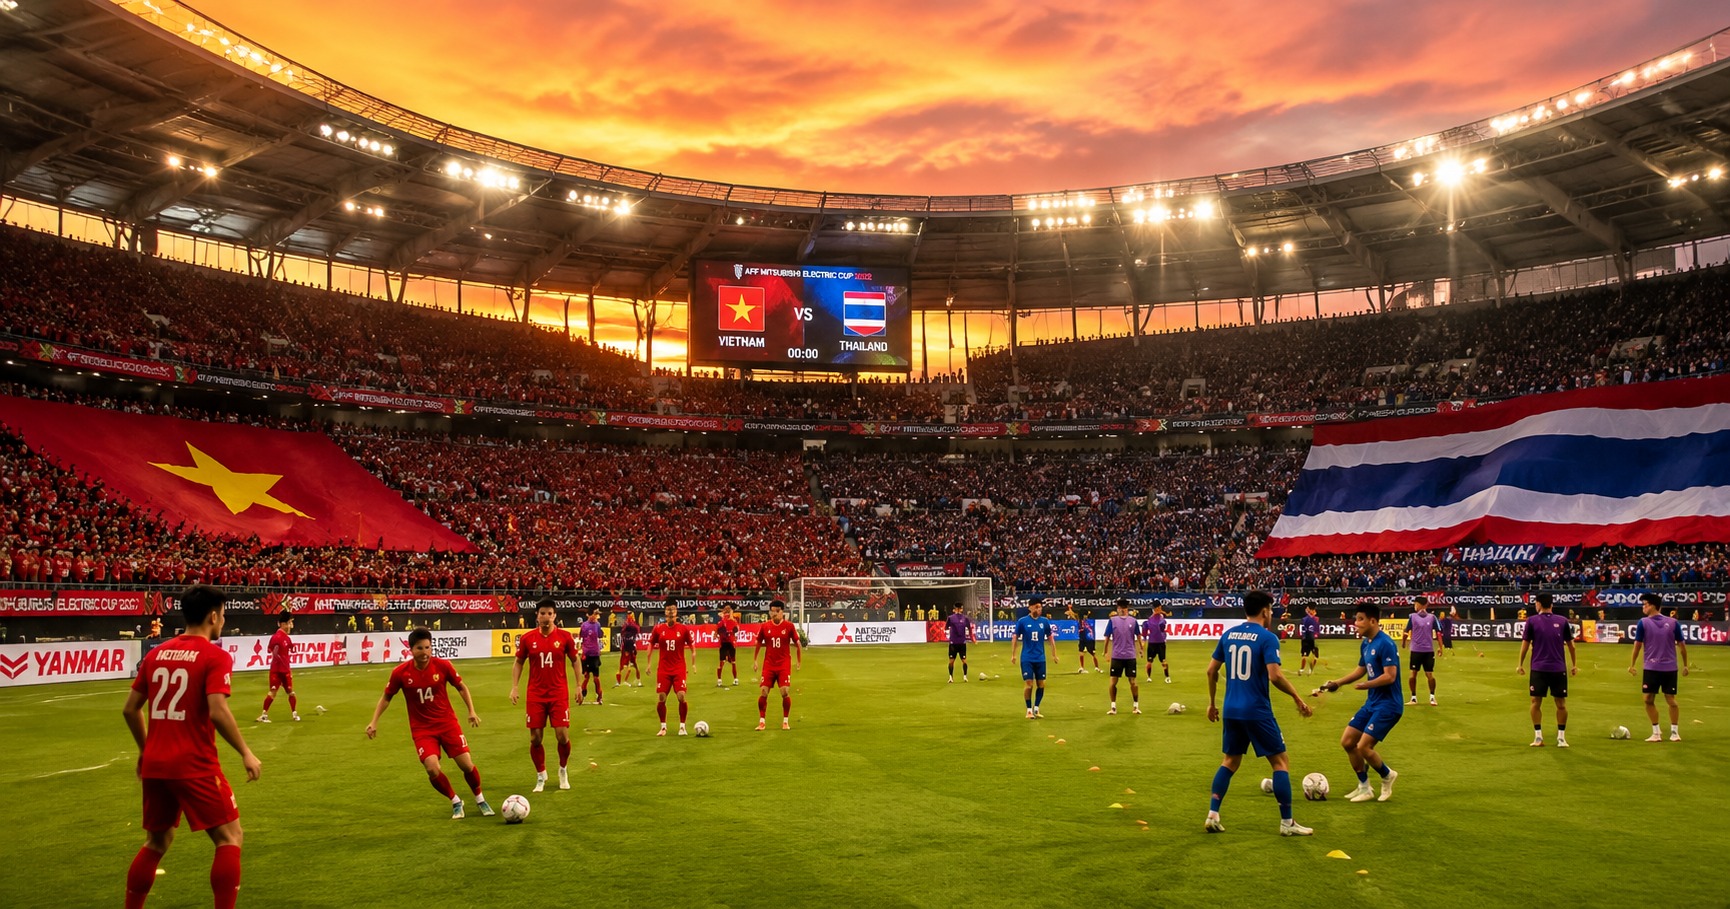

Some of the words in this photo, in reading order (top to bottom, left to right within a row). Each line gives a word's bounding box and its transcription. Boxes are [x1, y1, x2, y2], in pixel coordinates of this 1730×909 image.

[745, 267, 759, 275] AFF
[803, 270, 837, 279] ELECTRIC
[838, 272, 854, 280] CUP
[794, 307, 813, 321] VS
[718, 336, 765, 347] VIETNAM
[839, 340, 888, 352] THAILAND
[787, 348, 819, 359] 00:00
[771, 637, 781, 648] 18
[34, 648, 125, 677] YANMAR
[539, 651, 554, 669] 14
[1228, 644, 1252, 681] 10
[151, 666, 189, 721] 22
[416, 686, 434, 704] 14
